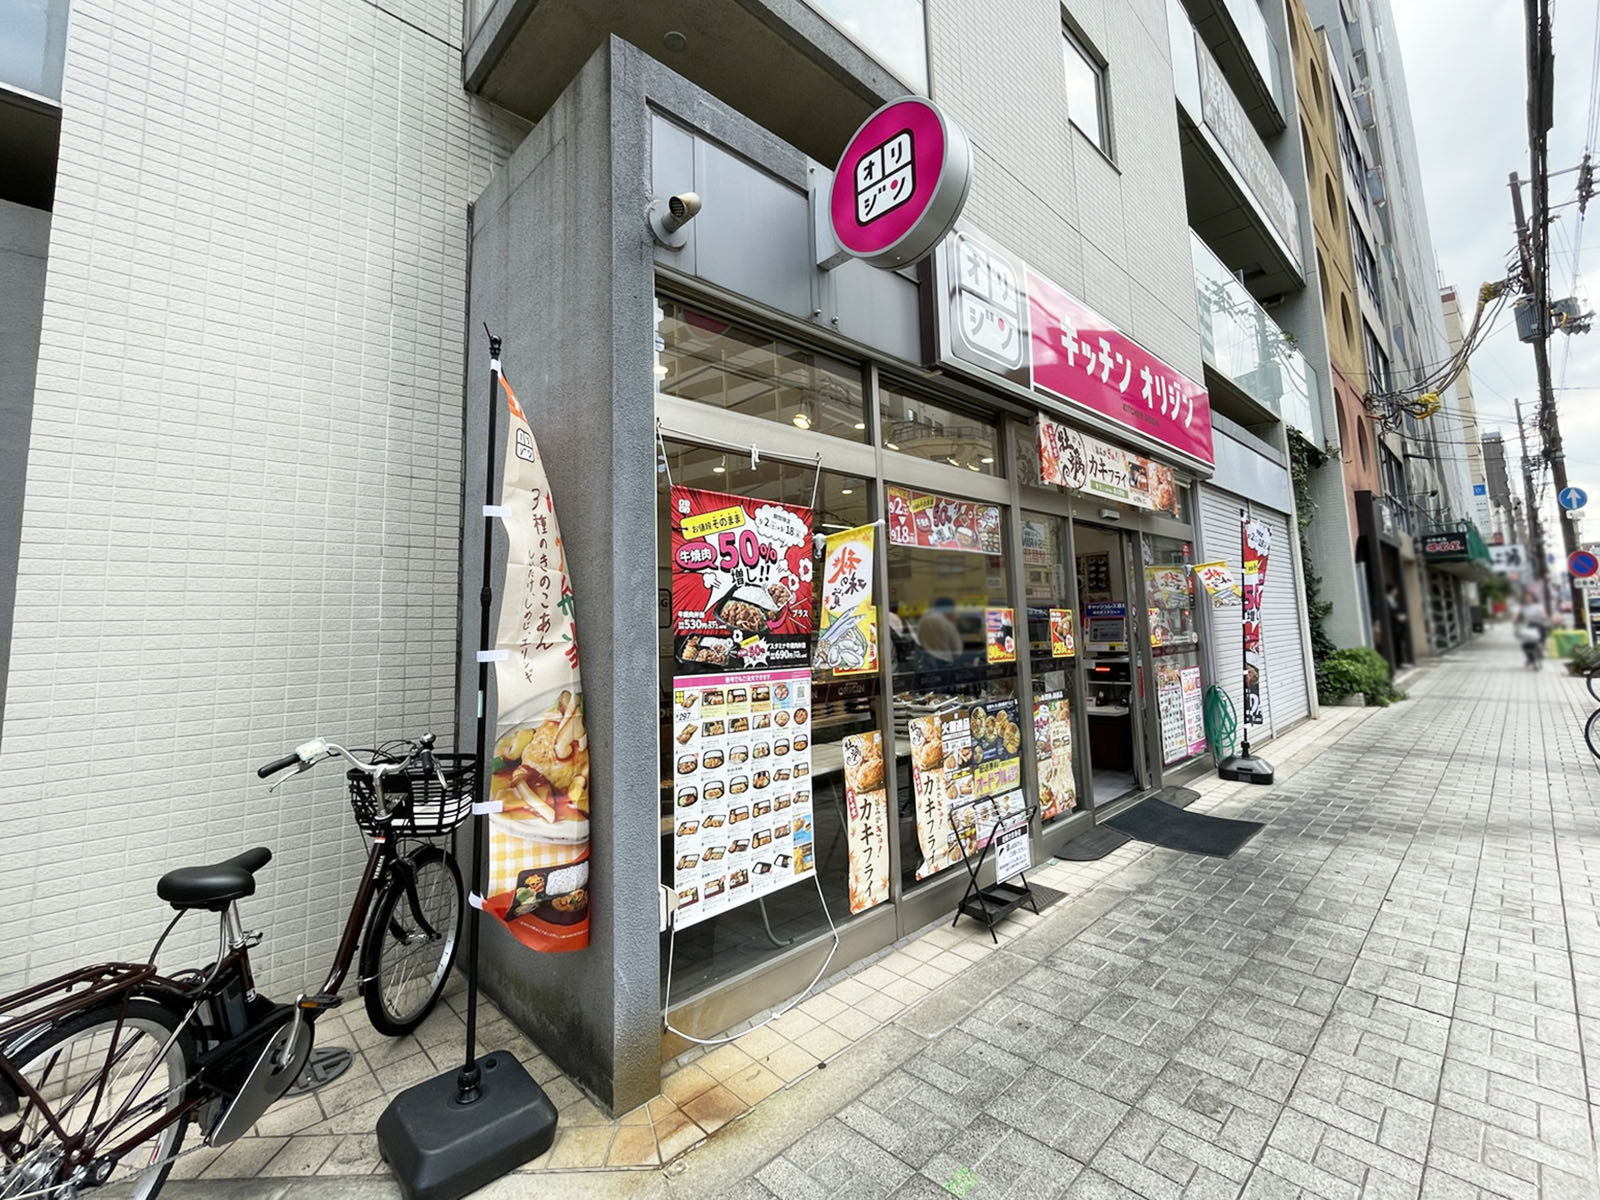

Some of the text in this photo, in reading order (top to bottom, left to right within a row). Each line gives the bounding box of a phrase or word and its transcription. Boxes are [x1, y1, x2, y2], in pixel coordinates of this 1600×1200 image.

[1059, 315, 1194, 429] キッチン オリジン
[1088, 454, 1128, 488] カキフライ
[679, 548, 713, 564] 牛焼肉
[718, 530, 778, 573] 50%
[859, 797, 876, 898] カキフライ
[923, 775, 937, 866] カキフライ
